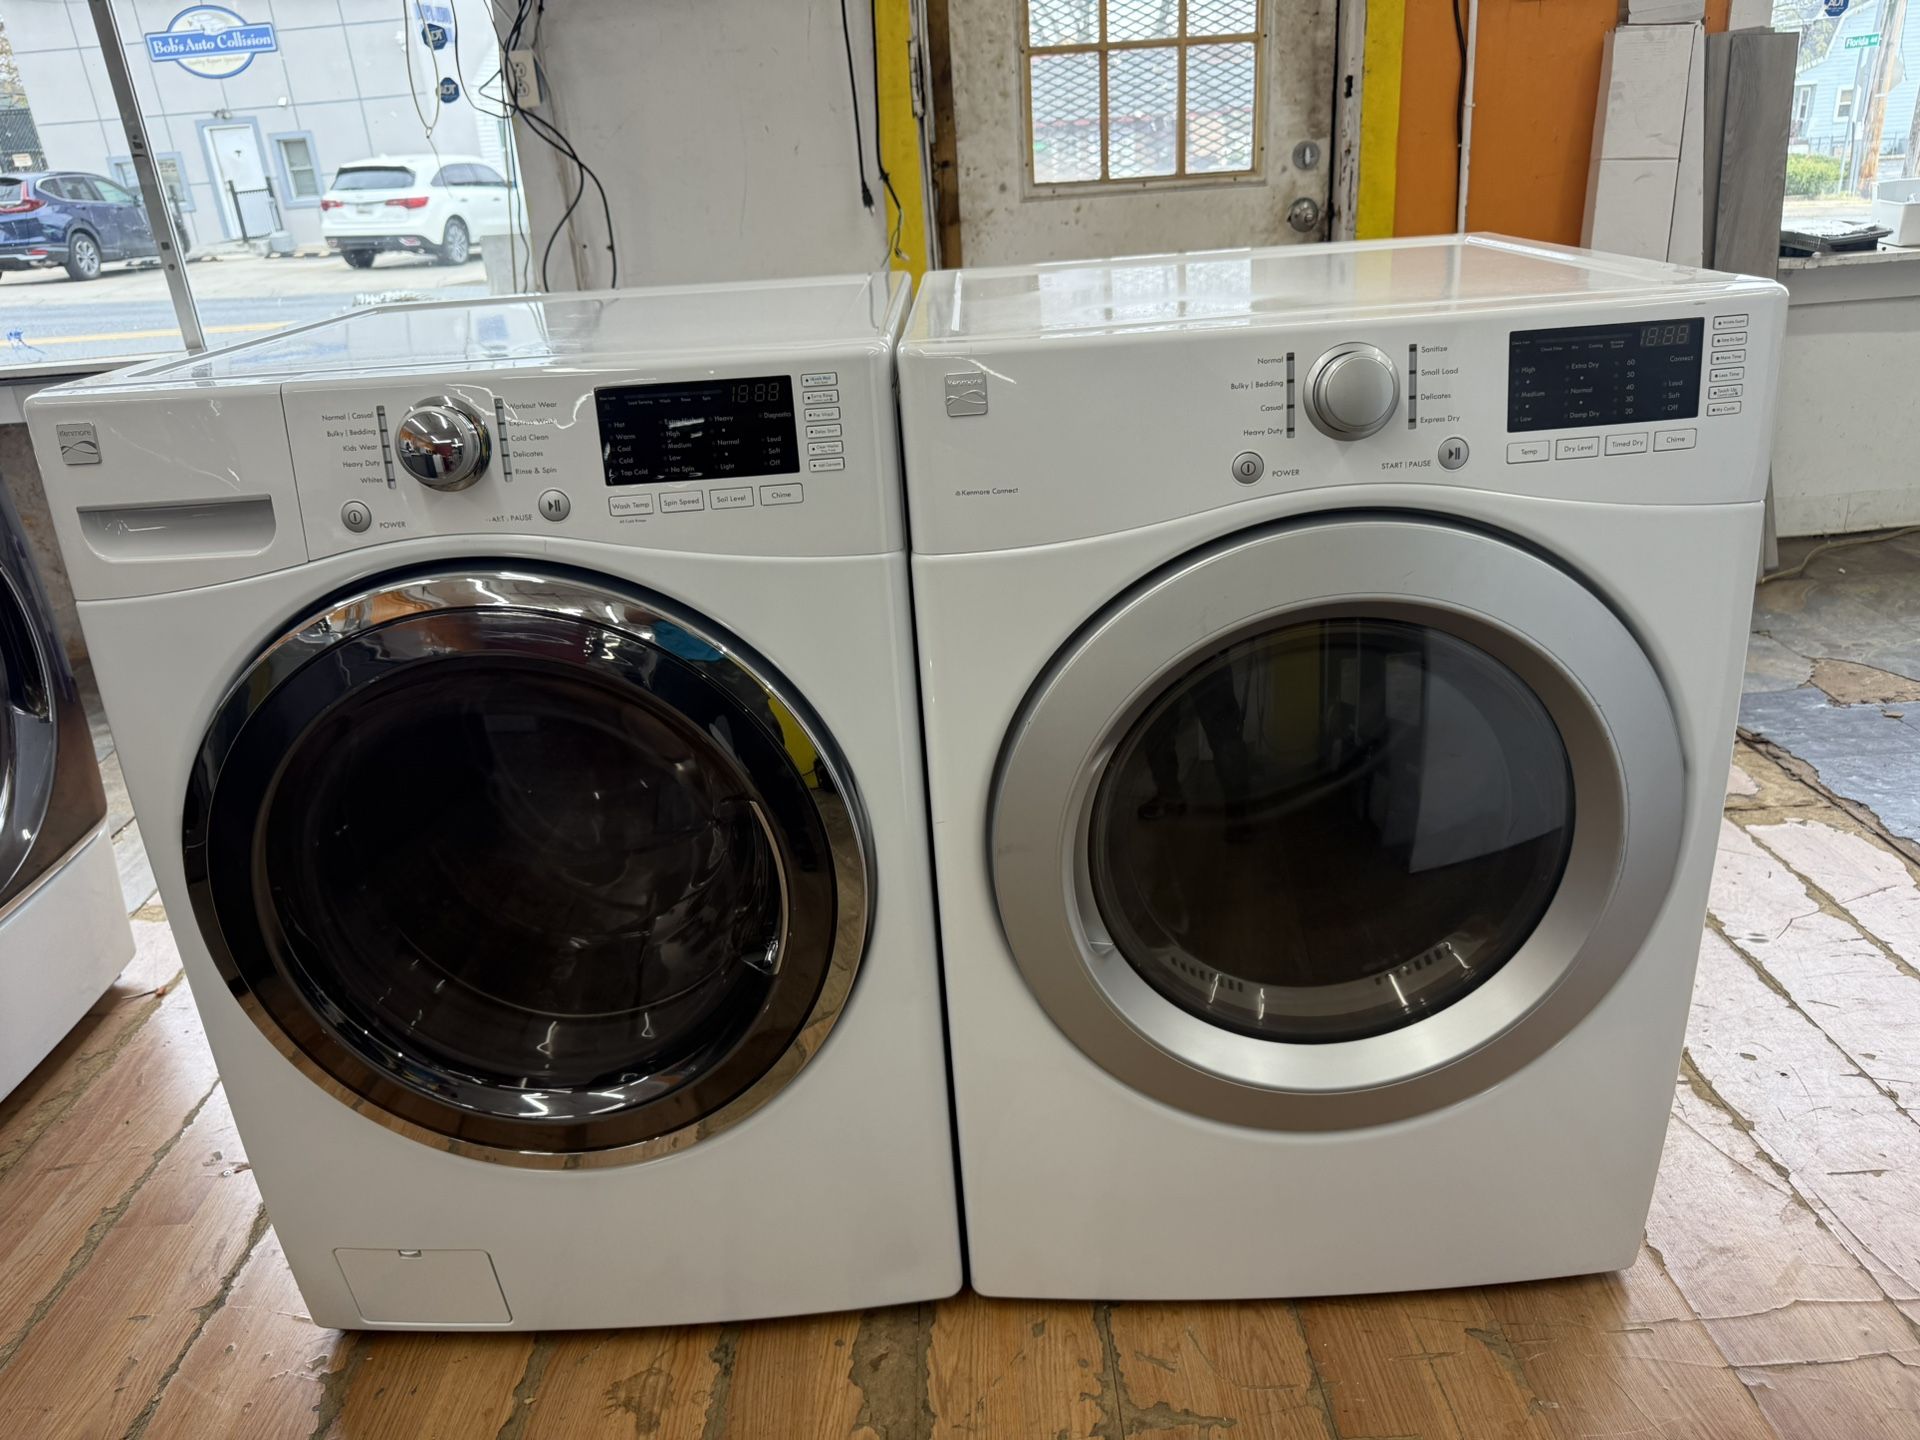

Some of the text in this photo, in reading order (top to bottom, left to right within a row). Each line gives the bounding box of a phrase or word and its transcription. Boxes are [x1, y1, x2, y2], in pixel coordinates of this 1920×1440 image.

[152, 32, 271, 54] Bob's Auto Collision
[1846, 35, 1869, 48] Florida
[1420, 345, 1448, 353] Sanitize
[1257, 356, 1284, 365] Normal
[1669, 355, 1694, 363] Connect
[1588, 362, 1600, 370] Dry
[1420, 367, 1459, 377] Small Load
[1230, 379, 1284, 391] Bulky Bedding
[1570, 387, 1593, 395] Normal
[1420, 391, 1451, 401] Delicates
[538, 401, 557, 409] Wear
[1260, 403, 1284, 412] Casual
[321, 411, 374, 422] Normal Casual
[1588, 410, 1600, 419] Dry
[714, 416, 734, 424] Heavy
[1420, 414, 1461, 426] Express Dry
[327, 428, 376, 438] Bulky Bedding
[1243, 426, 1284, 437] Heavy Duty
[511, 433, 549, 442] Cold Clean
[717, 438, 740, 446] Normal
[766, 435, 782, 443] Loud
[1666, 435, 1686, 443] Chime
[342, 443, 378, 452] Kids Wear
[1612, 438, 1644, 448] Timed Dry
[768, 447, 781, 455] Soft
[1521, 448, 1538, 457] Temp
[1564, 443, 1593, 454] Dry Level
[513, 450, 543, 458] Delicates
[342, 460, 381, 469] Heavy Duty
[769, 458, 781, 466] Off
[1381, 459, 1432, 470] START PAUSE
[515, 466, 557, 475] Rinse & Spin
[681, 465, 695, 474] Spin
[720, 463, 735, 471] Light
[633, 468, 649, 476] Cold
[1272, 468, 1300, 477] POWER
[360, 477, 383, 485] Whites
[771, 490, 792, 499] Chime
[961, 487, 1019, 497] Kenmore Connect
[663, 496, 700, 507] Spin Speed
[716, 494, 747, 503] Soil Level
[612, 501, 650, 511] Wash Temp
[510, 513, 534, 522] PAUSE
[379, 521, 407, 529] POWER
